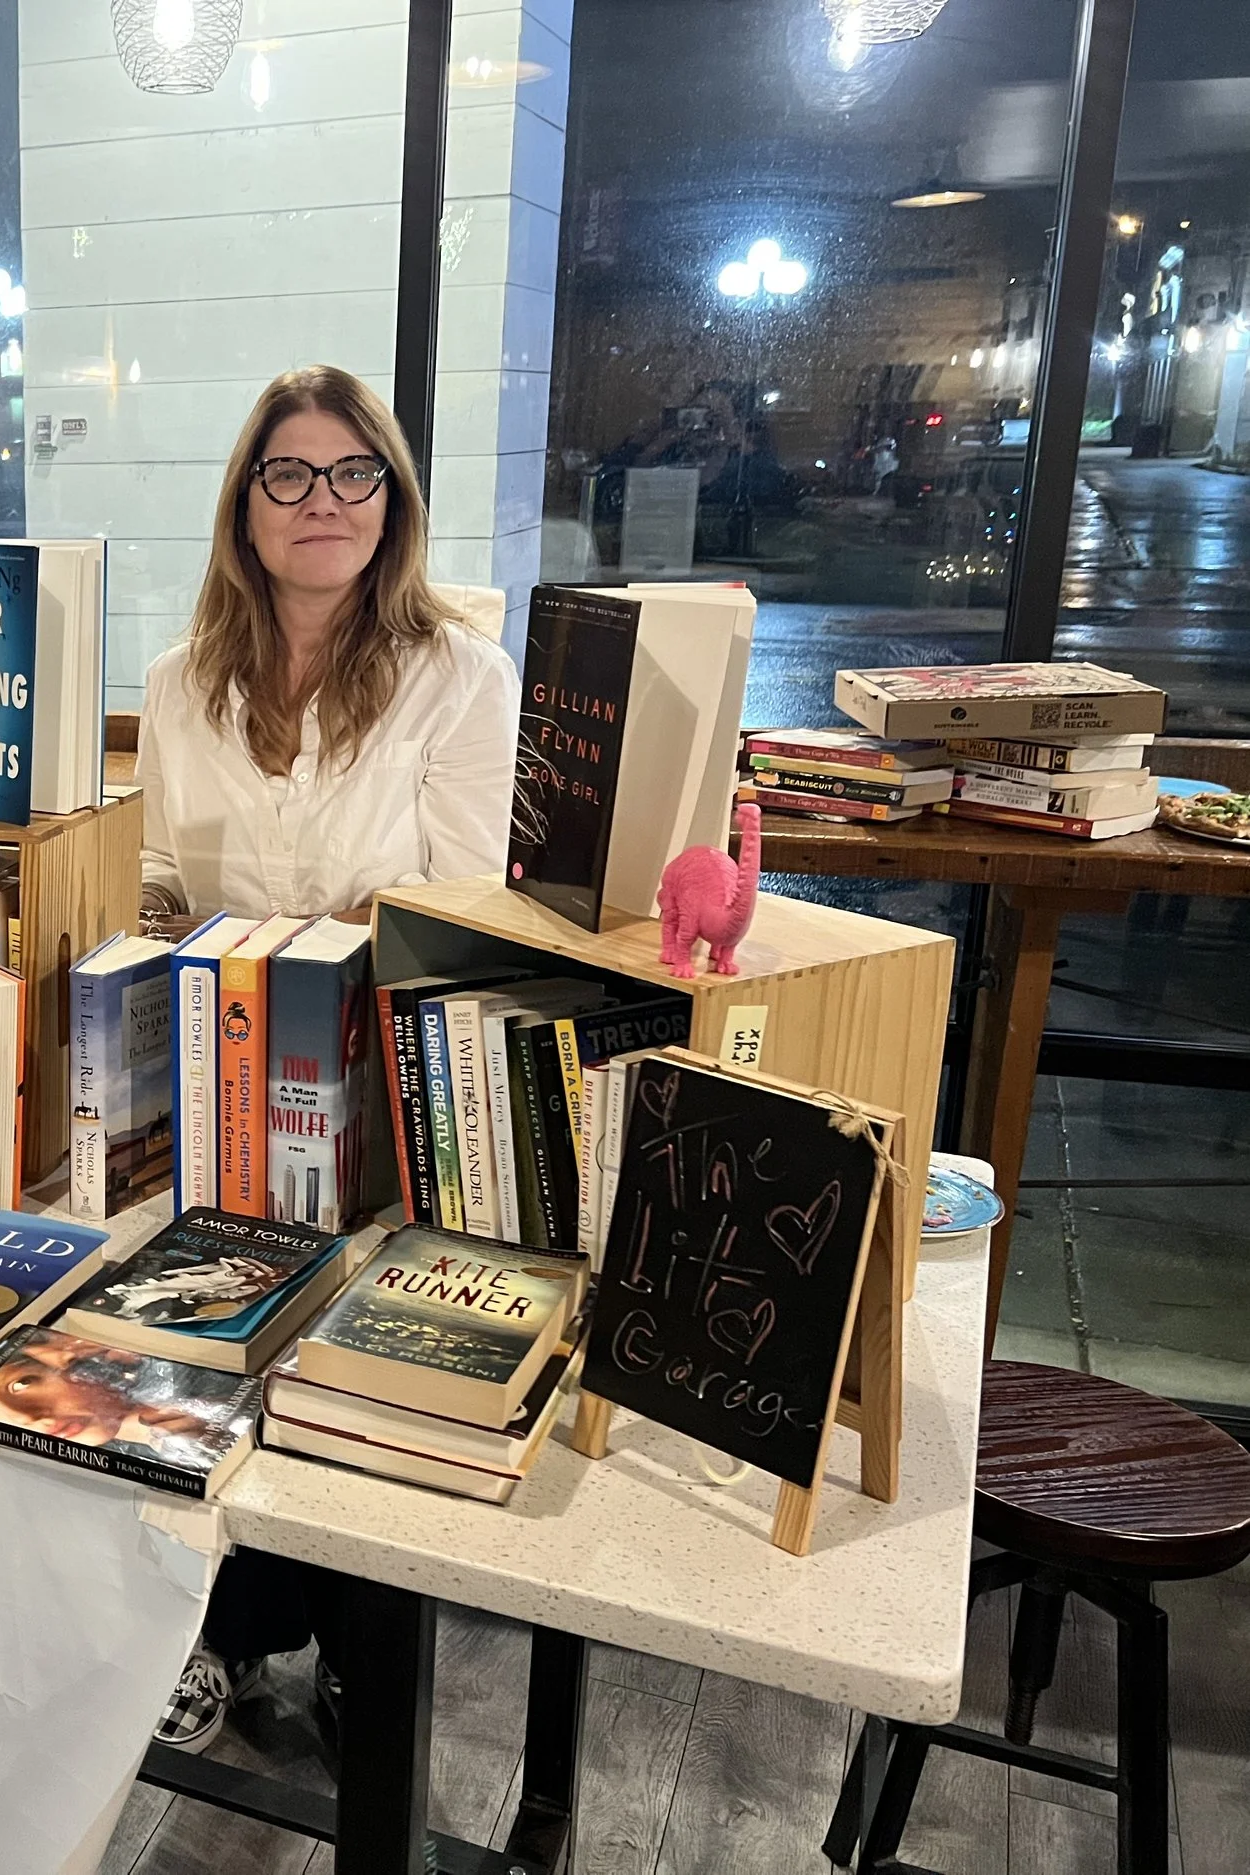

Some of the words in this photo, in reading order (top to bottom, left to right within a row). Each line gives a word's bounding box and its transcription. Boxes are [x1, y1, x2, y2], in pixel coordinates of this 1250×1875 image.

[532, 683, 616, 723] GILLIAN
[1064, 711, 1101, 720] LEARN.
[1065, 702, 1096, 710] SCAN.
[540, 726, 601, 764] FLYNN
[969, 740, 997, 752] WOLF
[530, 765, 568, 792] GONE
[571, 780, 601, 806] GIRL
[783, 777, 833, 791] SEABISCUIT
[80, 981, 94, 1007] The
[191, 976, 202, 1012] AMOR
[76, 1013, 93, 1060] Longest
[191, 1018, 202, 1061] TOWLES
[404, 1015, 417, 1061] WHERE
[423, 1014, 443, 1076] DARING
[560, 1031, 575, 1071] BORN
[586, 1013, 687, 1055] TREVOR
[281, 1055, 319, 1085] TOM
[393, 1015, 405, 1051] DELIA
[399, 1055, 410, 1099] OWENS
[458, 1037, 474, 1097] WHITE
[492, 1049, 502, 1076] Just
[80, 1065, 94, 1096] Ride
[192, 1086, 203, 1105] THE
[239, 1057, 250, 1113] LESSONS
[279, 1085, 288, 1093] A
[292, 1086, 318, 1097] Man
[409, 1064, 419, 1092] THE
[567, 1077, 577, 1086] A
[224, 1079, 234, 1121] Bonnie
[280, 1095, 291, 1104] in
[294, 1096, 317, 1107] Full
[430, 1079, 451, 1152] GREATLY
[494, 1083, 505, 1124] Mercy
[569, 1091, 582, 1136] CRIME
[583, 1113, 592, 1127] OF
[193, 1110, 203, 1158] LINCOLN
[240, 1119, 247, 1128] in
[270, 1106, 329, 1139] WOLFE
[411, 1097, 427, 1172] CRAWDADS
[520, 1041, 531, 1079] SHARP
[527, 1085, 541, 1139] OBJECTS
[537, 1149, 550, 1195] GILLIAN
[546, 1202, 556, 1238] FLYNN
[76, 1138, 84, 1177] SPARKS
[86, 1131, 96, 1185] NICHOLAS
[225, 1126, 234, 1174] Garmus
[239, 1129, 251, 1202] CHEMISTRY
[288, 1146, 306, 1154] FSG
[463, 1106, 483, 1206] OLEANDER
[581, 1130, 592, 1205] SPECULATION
[639, 1114, 787, 1211] The
[419, 1177, 431, 1209] SING
[172, 1231, 223, 1249] RULES
[190, 1217, 250, 1235] AMOR
[253, 1229, 320, 1250] TOWLES
[619, 1189, 766, 1317] Lit
[429, 1255, 520, 1290] KITE
[374, 1267, 534, 1319] RUNNER
[318, 1331, 391, 1355] KHALED
[397, 1351, 498, 1379] HOSSEINI
[13, 1435, 20, 1446] A
[20, 1432, 56, 1457] PEARL
[58, 1442, 110, 1470] EARRING
[116, 1460, 146, 1476] TRACY
[148, 1470, 201, 1491] CHEVALIER
